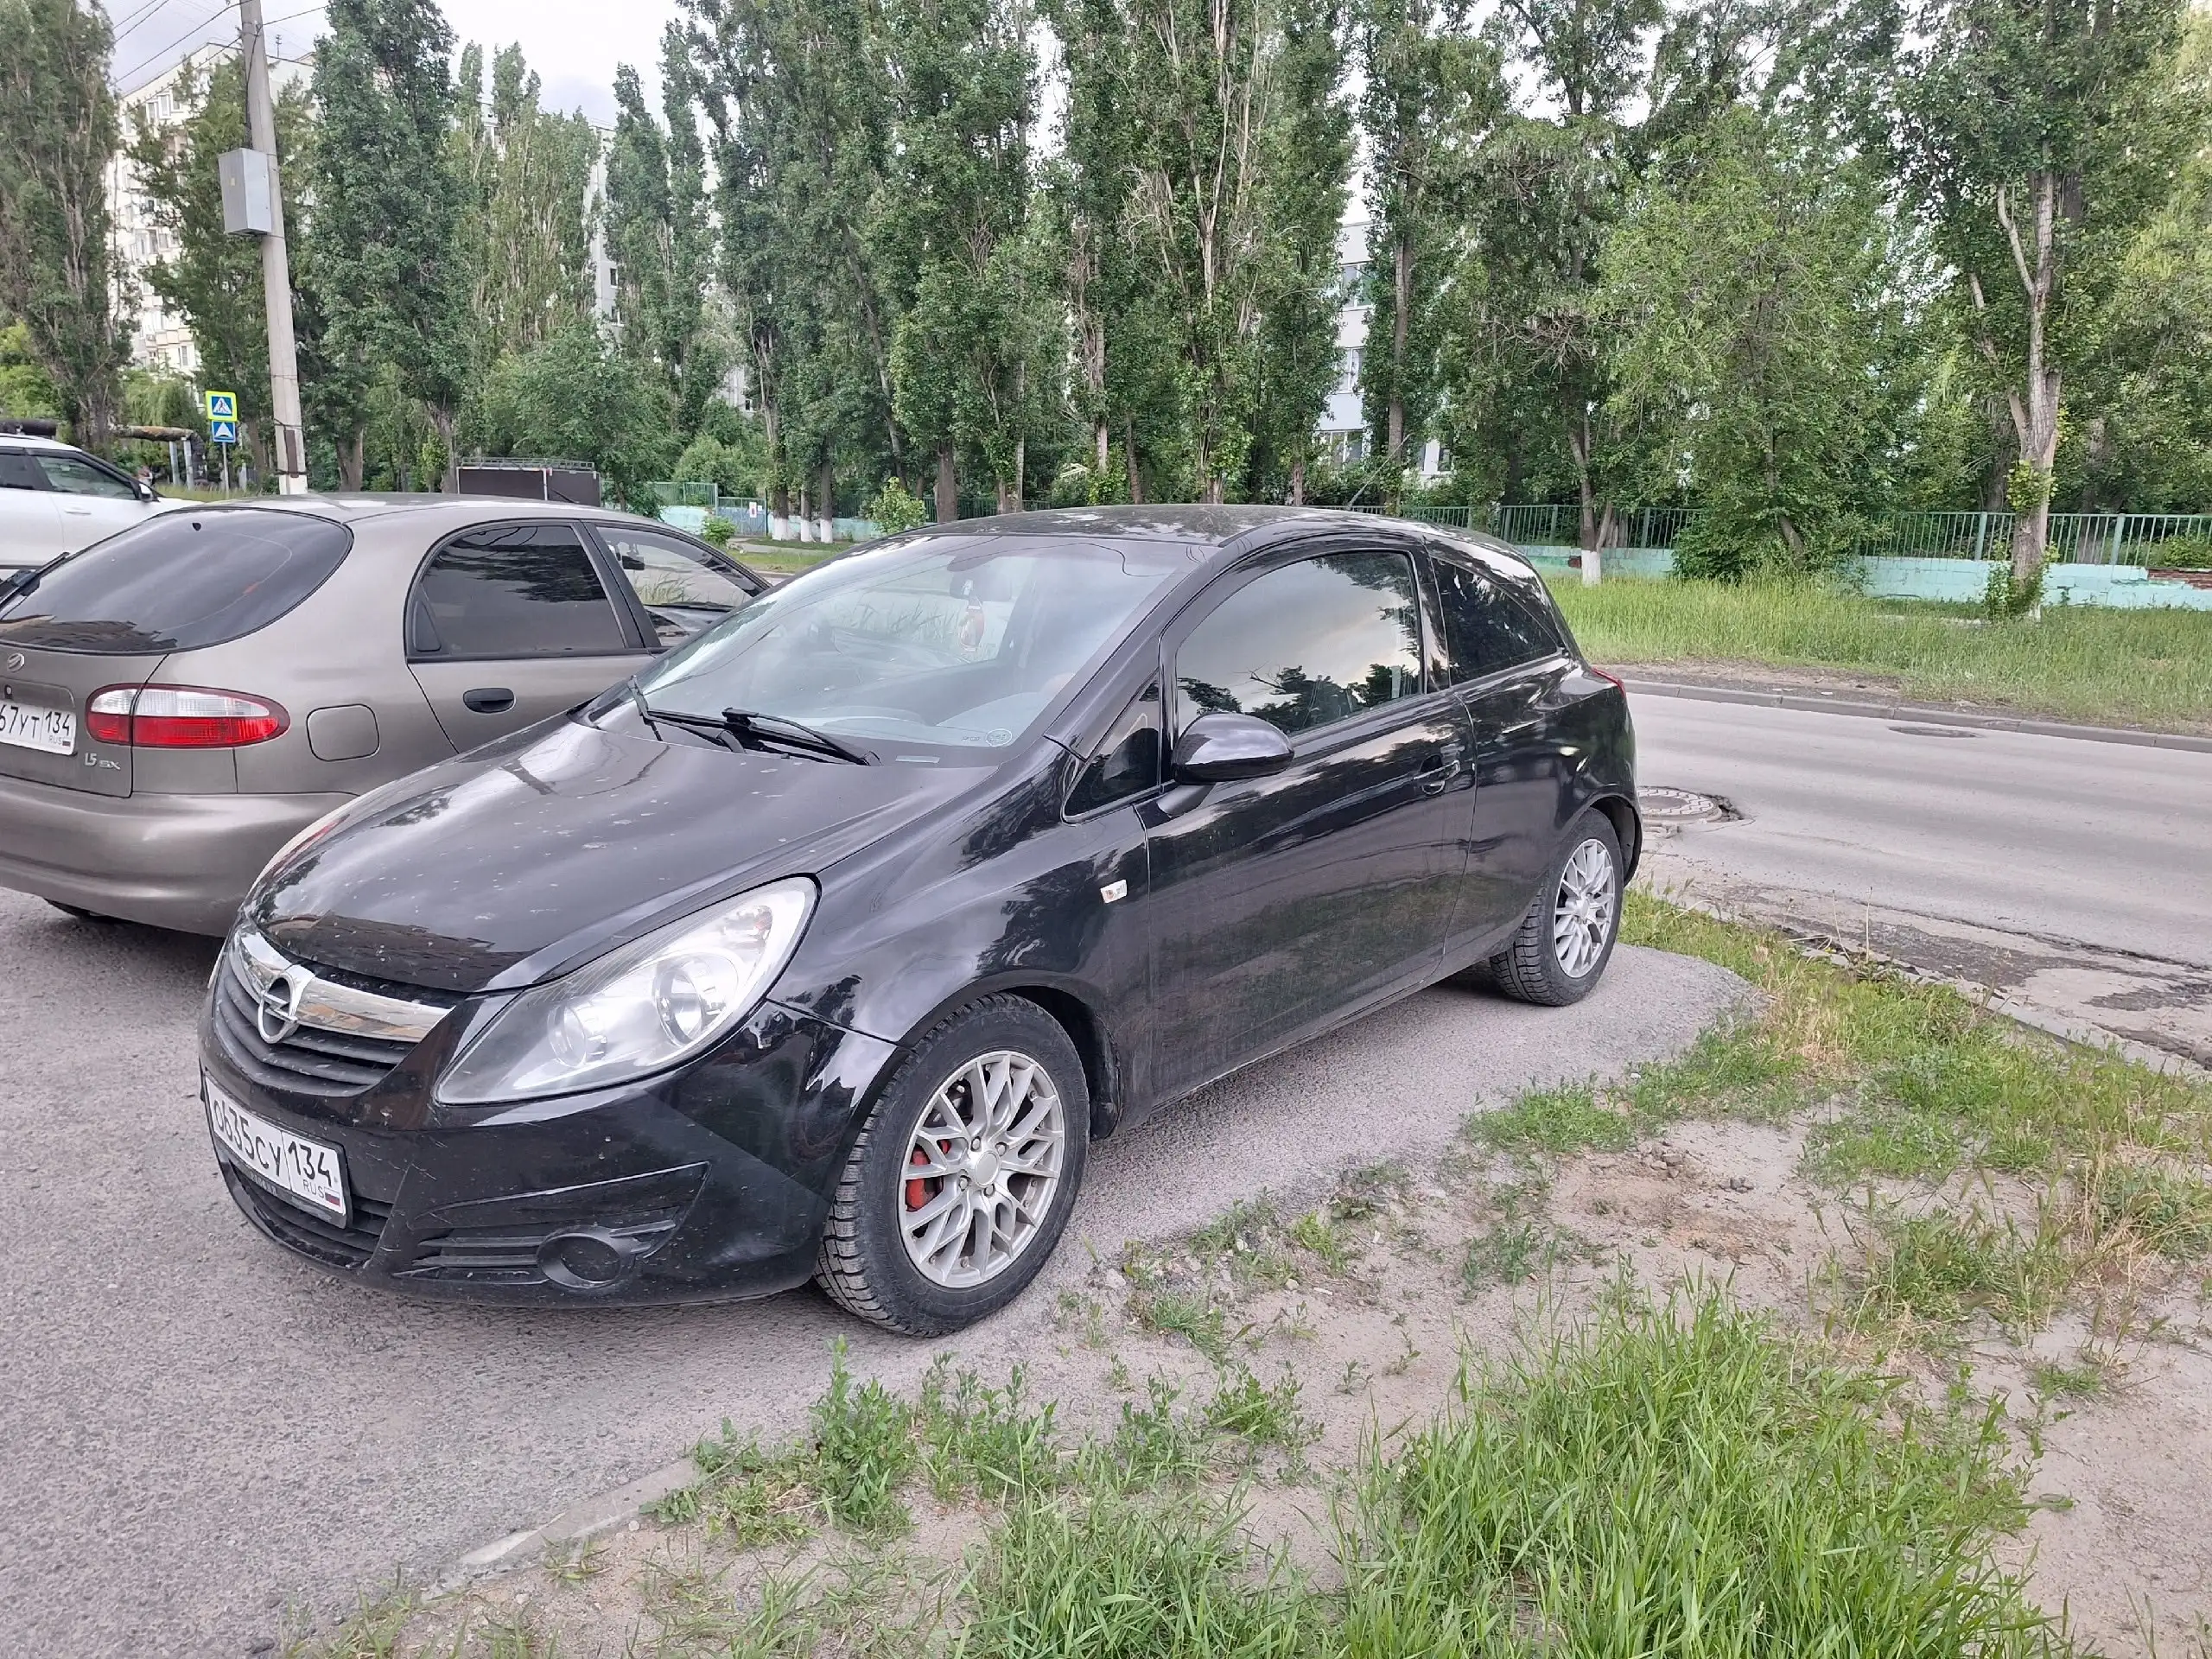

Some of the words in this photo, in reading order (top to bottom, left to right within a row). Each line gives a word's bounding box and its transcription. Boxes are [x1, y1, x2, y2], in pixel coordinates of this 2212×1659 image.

[45, 710, 71, 736] 134
[288, 1141, 332, 1188] 134
[302, 1179, 325, 1198] RUS
